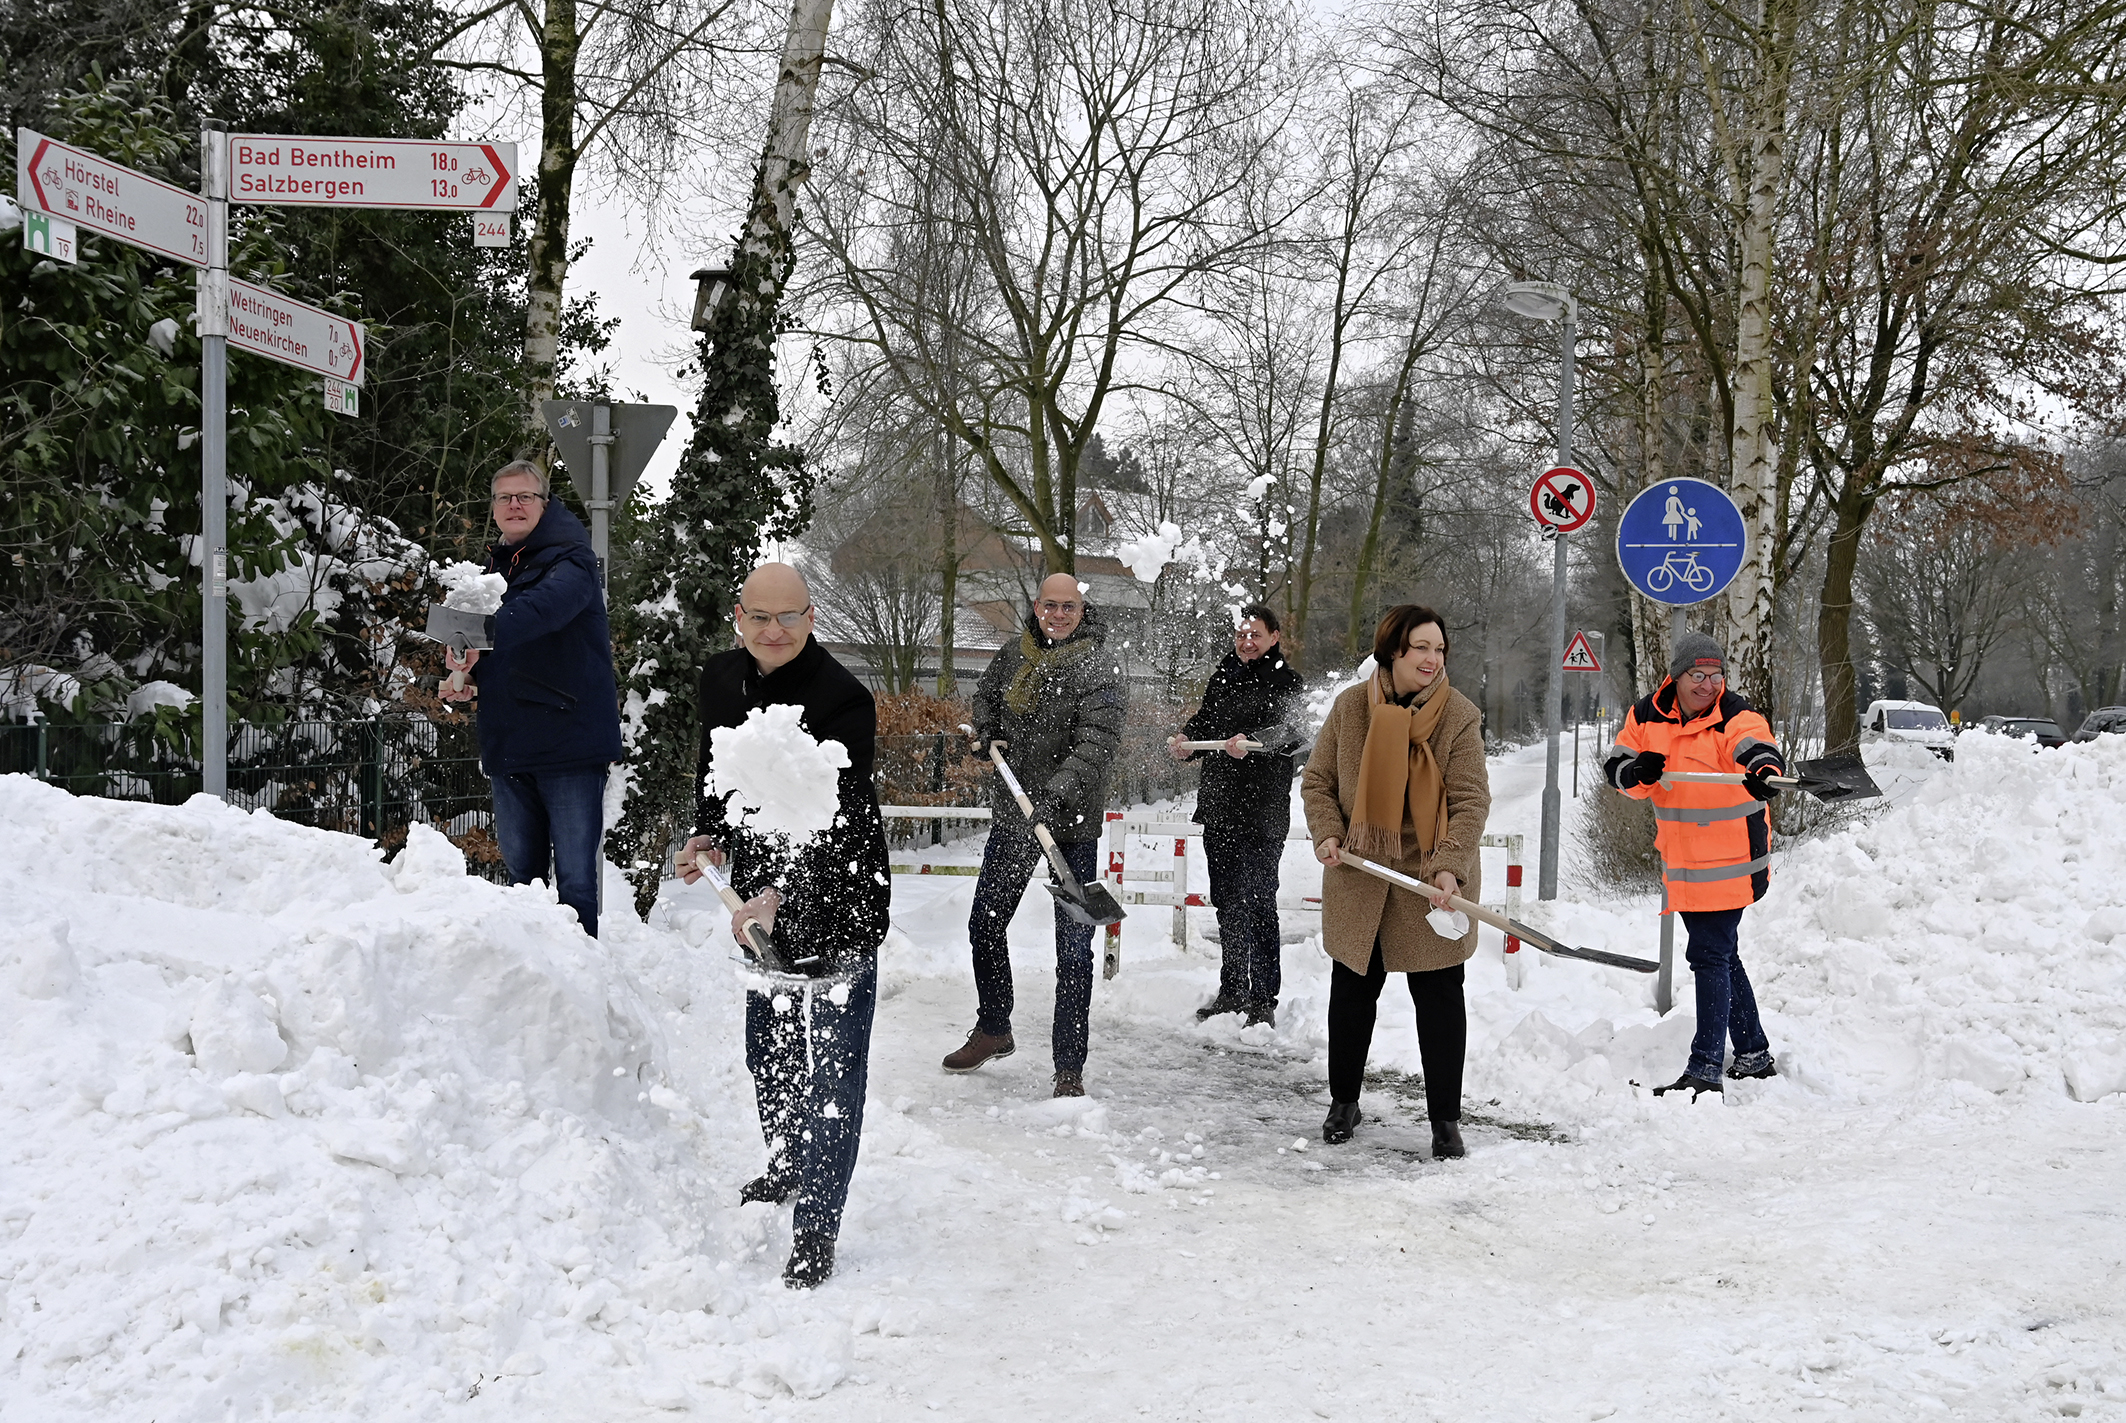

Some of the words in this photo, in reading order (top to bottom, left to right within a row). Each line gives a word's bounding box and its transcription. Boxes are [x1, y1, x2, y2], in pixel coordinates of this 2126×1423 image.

[239, 146, 280, 166] Bad
[290, 148, 396, 170] Bentheim
[65, 158, 119, 197] Hörstel
[240, 173, 364, 199] Salzbergen
[86, 195, 136, 231] Rheine
[477, 222, 506, 237] 244
[58, 241, 70, 258] 19
[230, 288, 293, 328] Wettringen
[229, 315, 308, 358] Neuenkirchen
[327, 379, 341, 394] 244
[329, 396, 339, 410] 20
